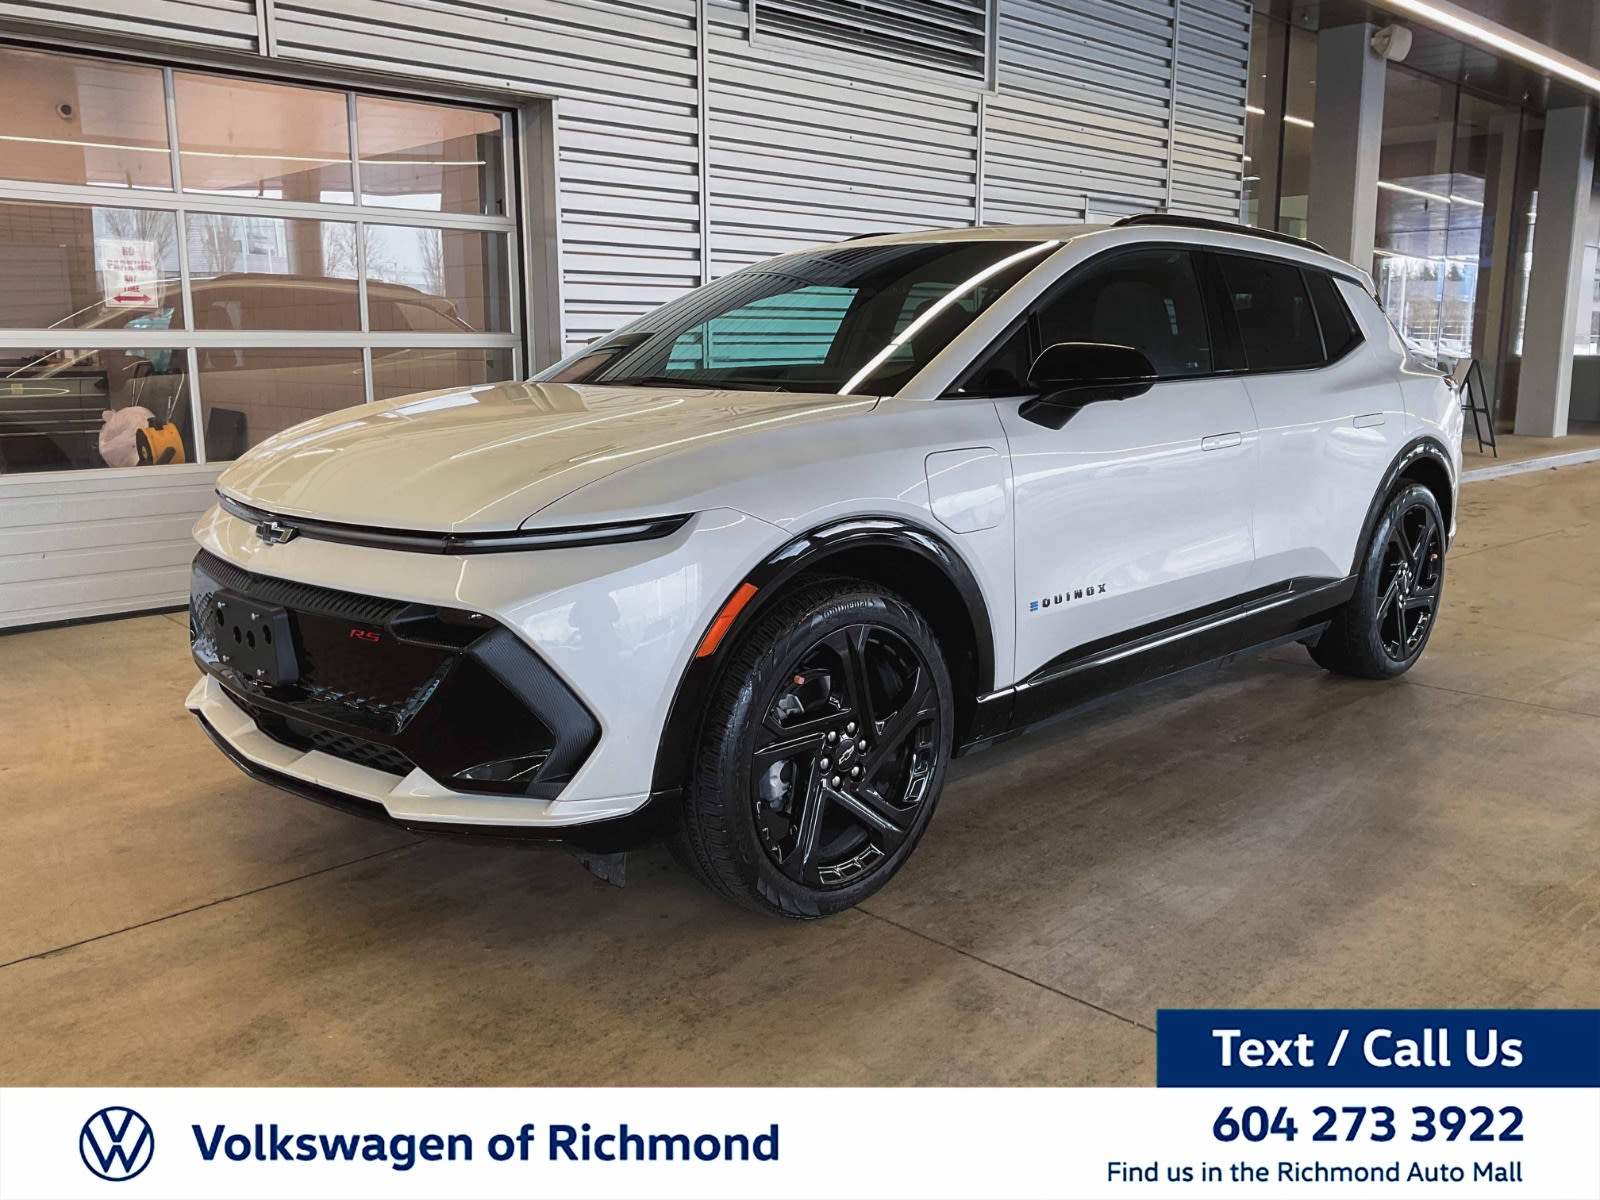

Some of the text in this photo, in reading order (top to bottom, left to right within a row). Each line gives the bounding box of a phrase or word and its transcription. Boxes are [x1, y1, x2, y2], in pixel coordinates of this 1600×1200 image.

[121, 246, 135, 256] NO
[1029, 583, 1107, 612] EQUINOX
[349, 629, 381, 642] RS
